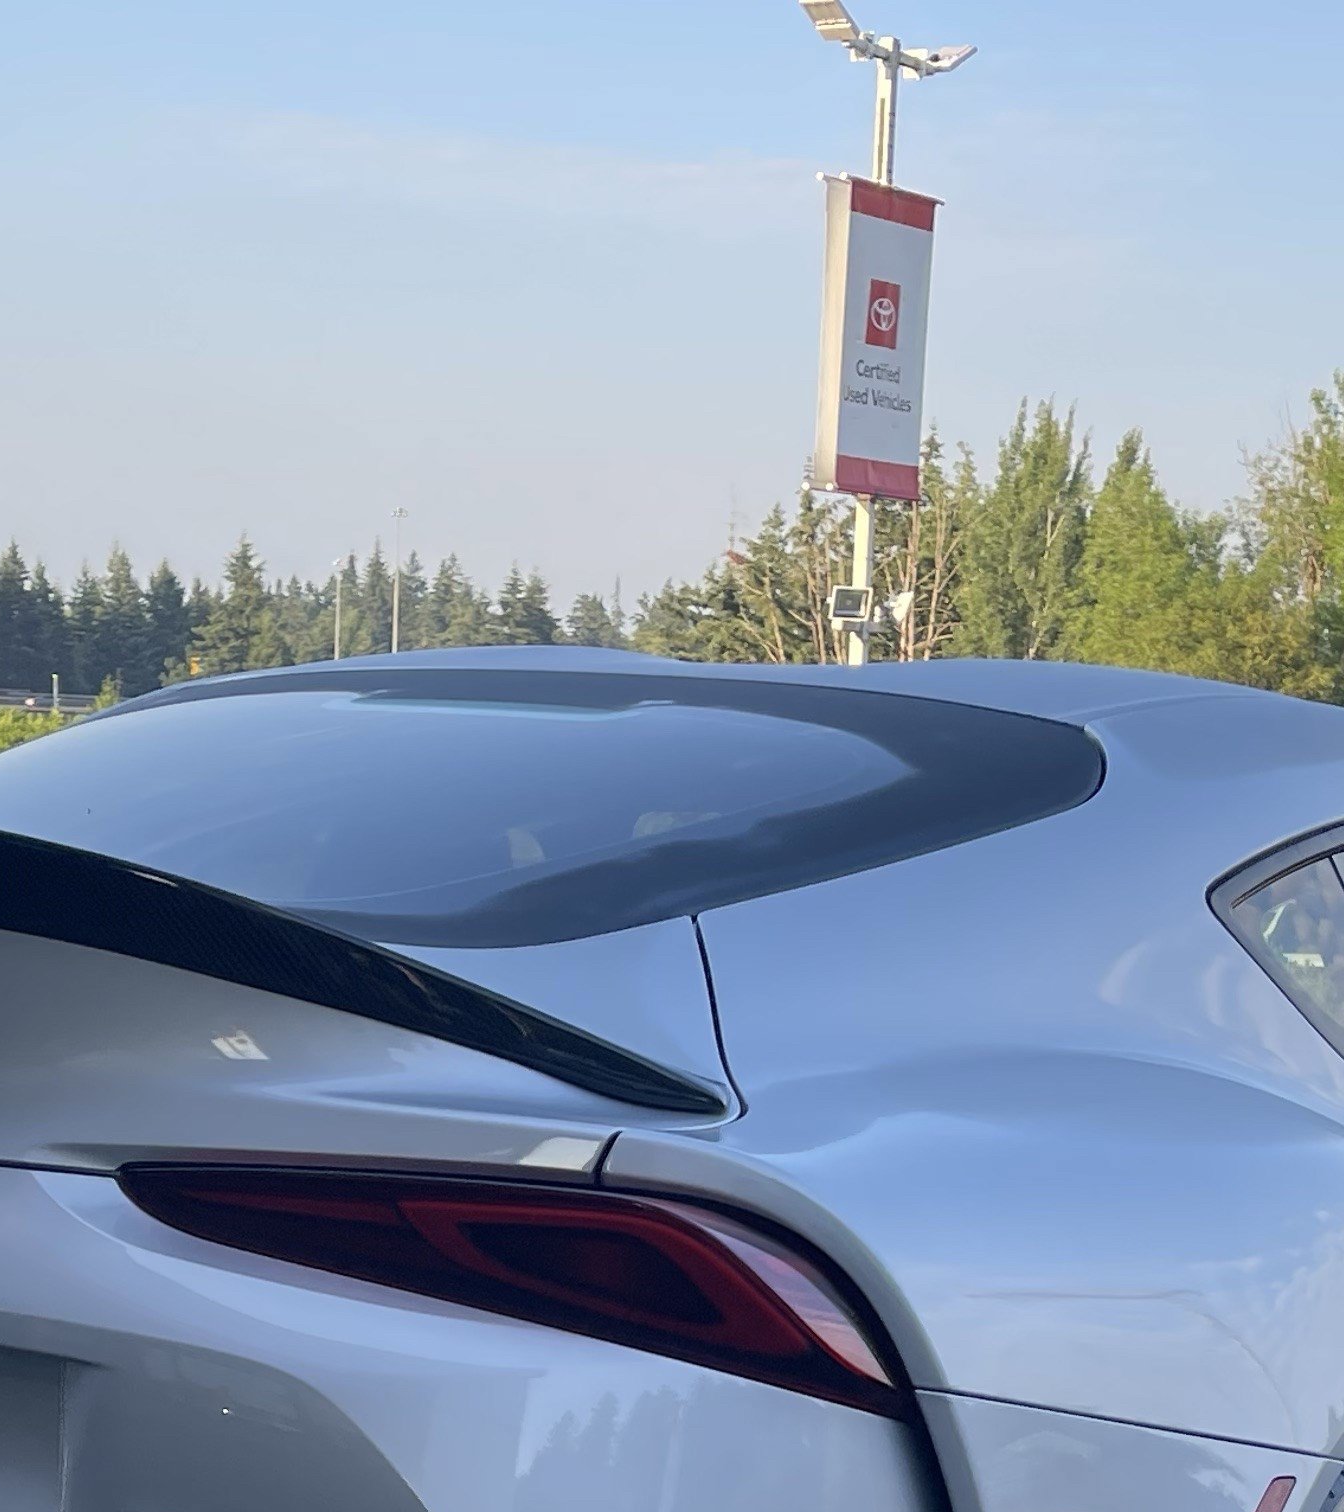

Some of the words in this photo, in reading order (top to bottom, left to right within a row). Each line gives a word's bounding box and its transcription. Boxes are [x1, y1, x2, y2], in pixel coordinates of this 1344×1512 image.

[856, 359, 901, 384] Certified
[843, 384, 869, 405] Used
[871, 388, 912, 413] Vehicles
